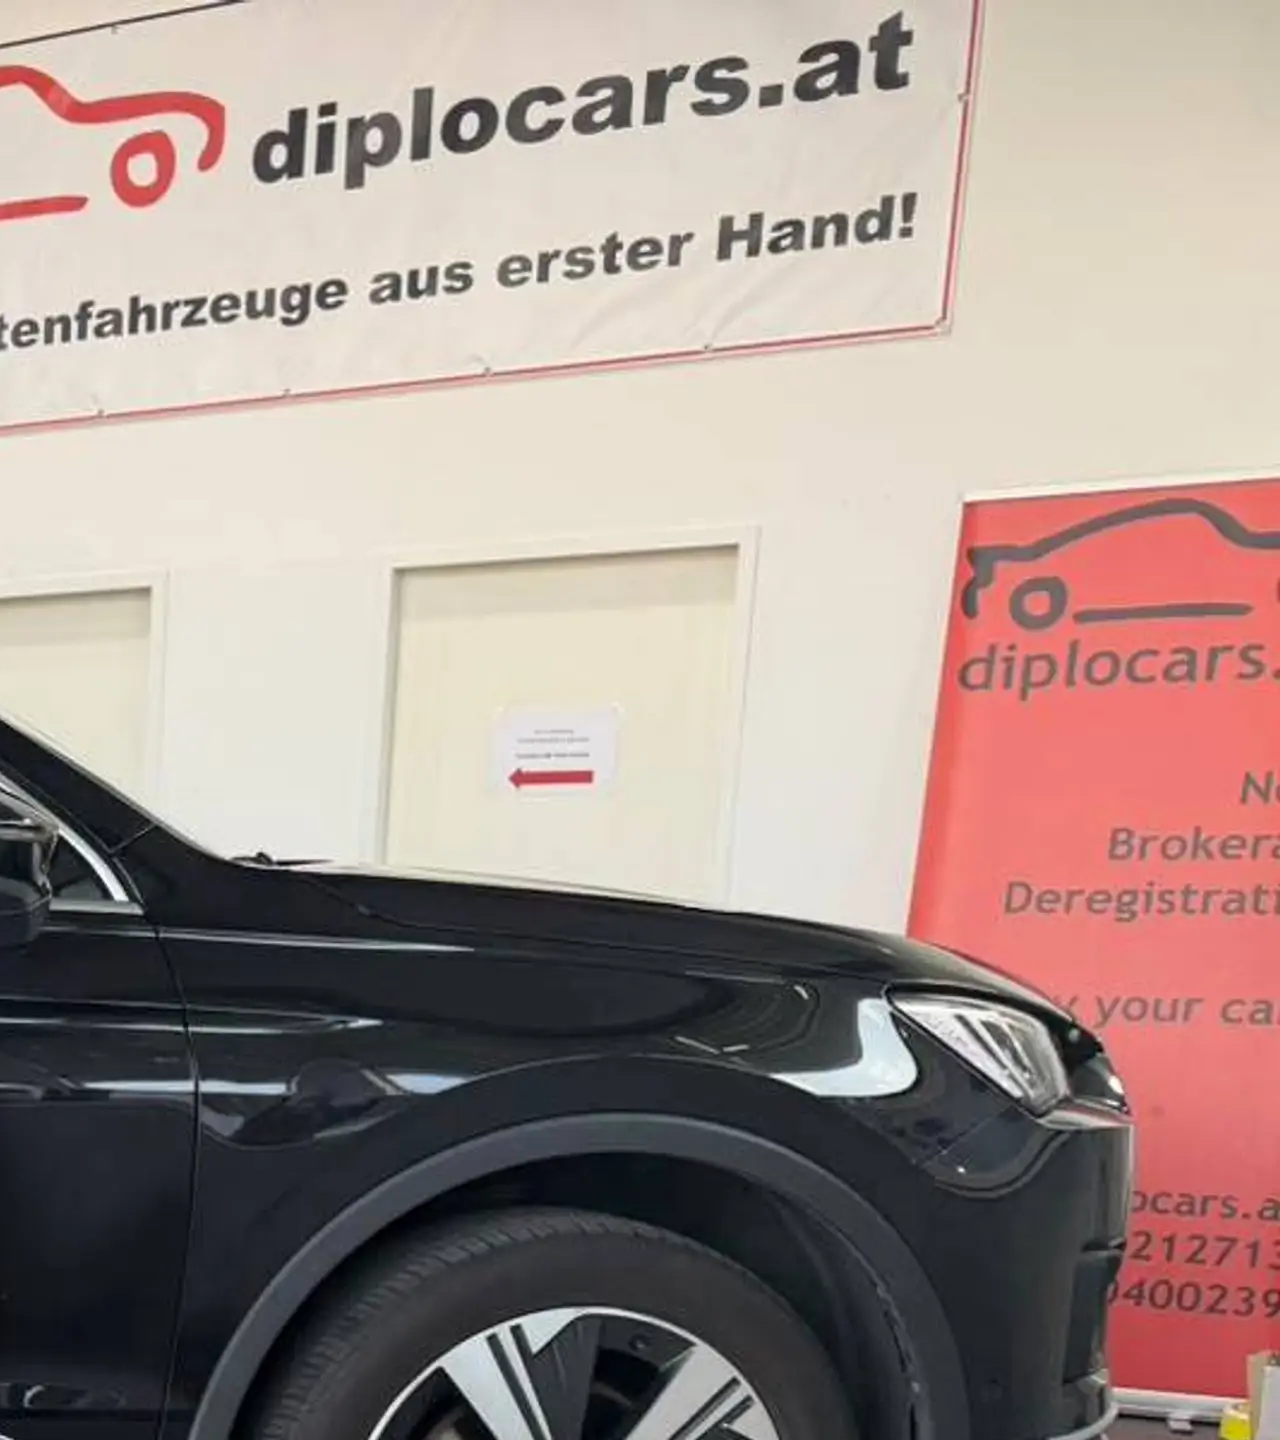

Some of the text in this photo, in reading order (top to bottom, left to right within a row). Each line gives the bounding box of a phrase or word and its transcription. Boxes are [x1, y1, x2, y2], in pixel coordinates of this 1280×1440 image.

[251, 11, 914, 190] diplocars.at
[368, 258, 474, 305] aus
[495, 231, 695, 289] erster
[715, 191, 919, 262] Hand!
[1240, 770, 1280, 805] N
[1092, 996, 1205, 1030] your
[1219, 998, 1280, 1026] ca
